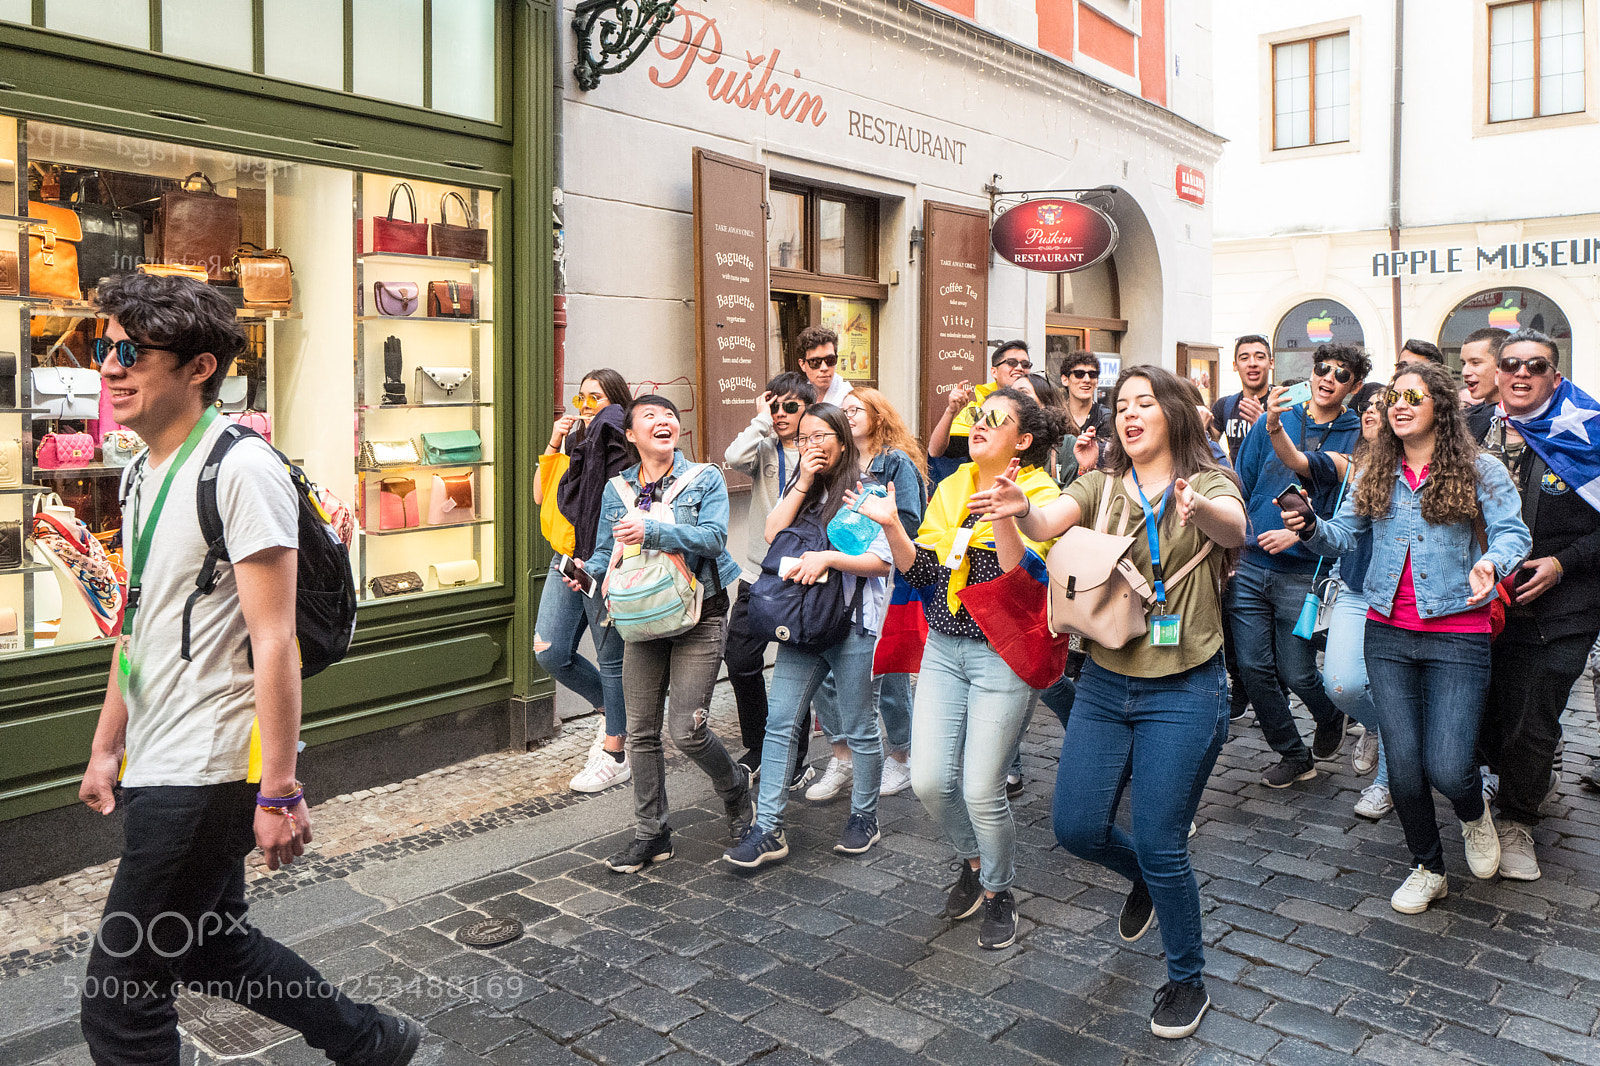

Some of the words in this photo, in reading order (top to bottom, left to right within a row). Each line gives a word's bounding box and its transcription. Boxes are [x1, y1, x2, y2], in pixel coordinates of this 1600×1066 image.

[648, 3, 827, 127] Puškin
[848, 109, 966, 165] RESTAURANT
[1025, 227, 1074, 245] Puškin
[715, 252, 754, 270] Baguette
[1014, 253, 1084, 263] RESTAURANT
[1372, 247, 1464, 277] APPLE
[1476, 237, 1600, 272] MUSEU
[965, 284, 978, 299] Tea
[716, 294, 755, 311] Baguette
[941, 315, 974, 327] Vittel
[717, 335, 756, 351] Baguette
[938, 347, 975, 361] Coca-Cola
[717, 376, 757, 392] Baguette
[936, 383, 959, 395] Orang
